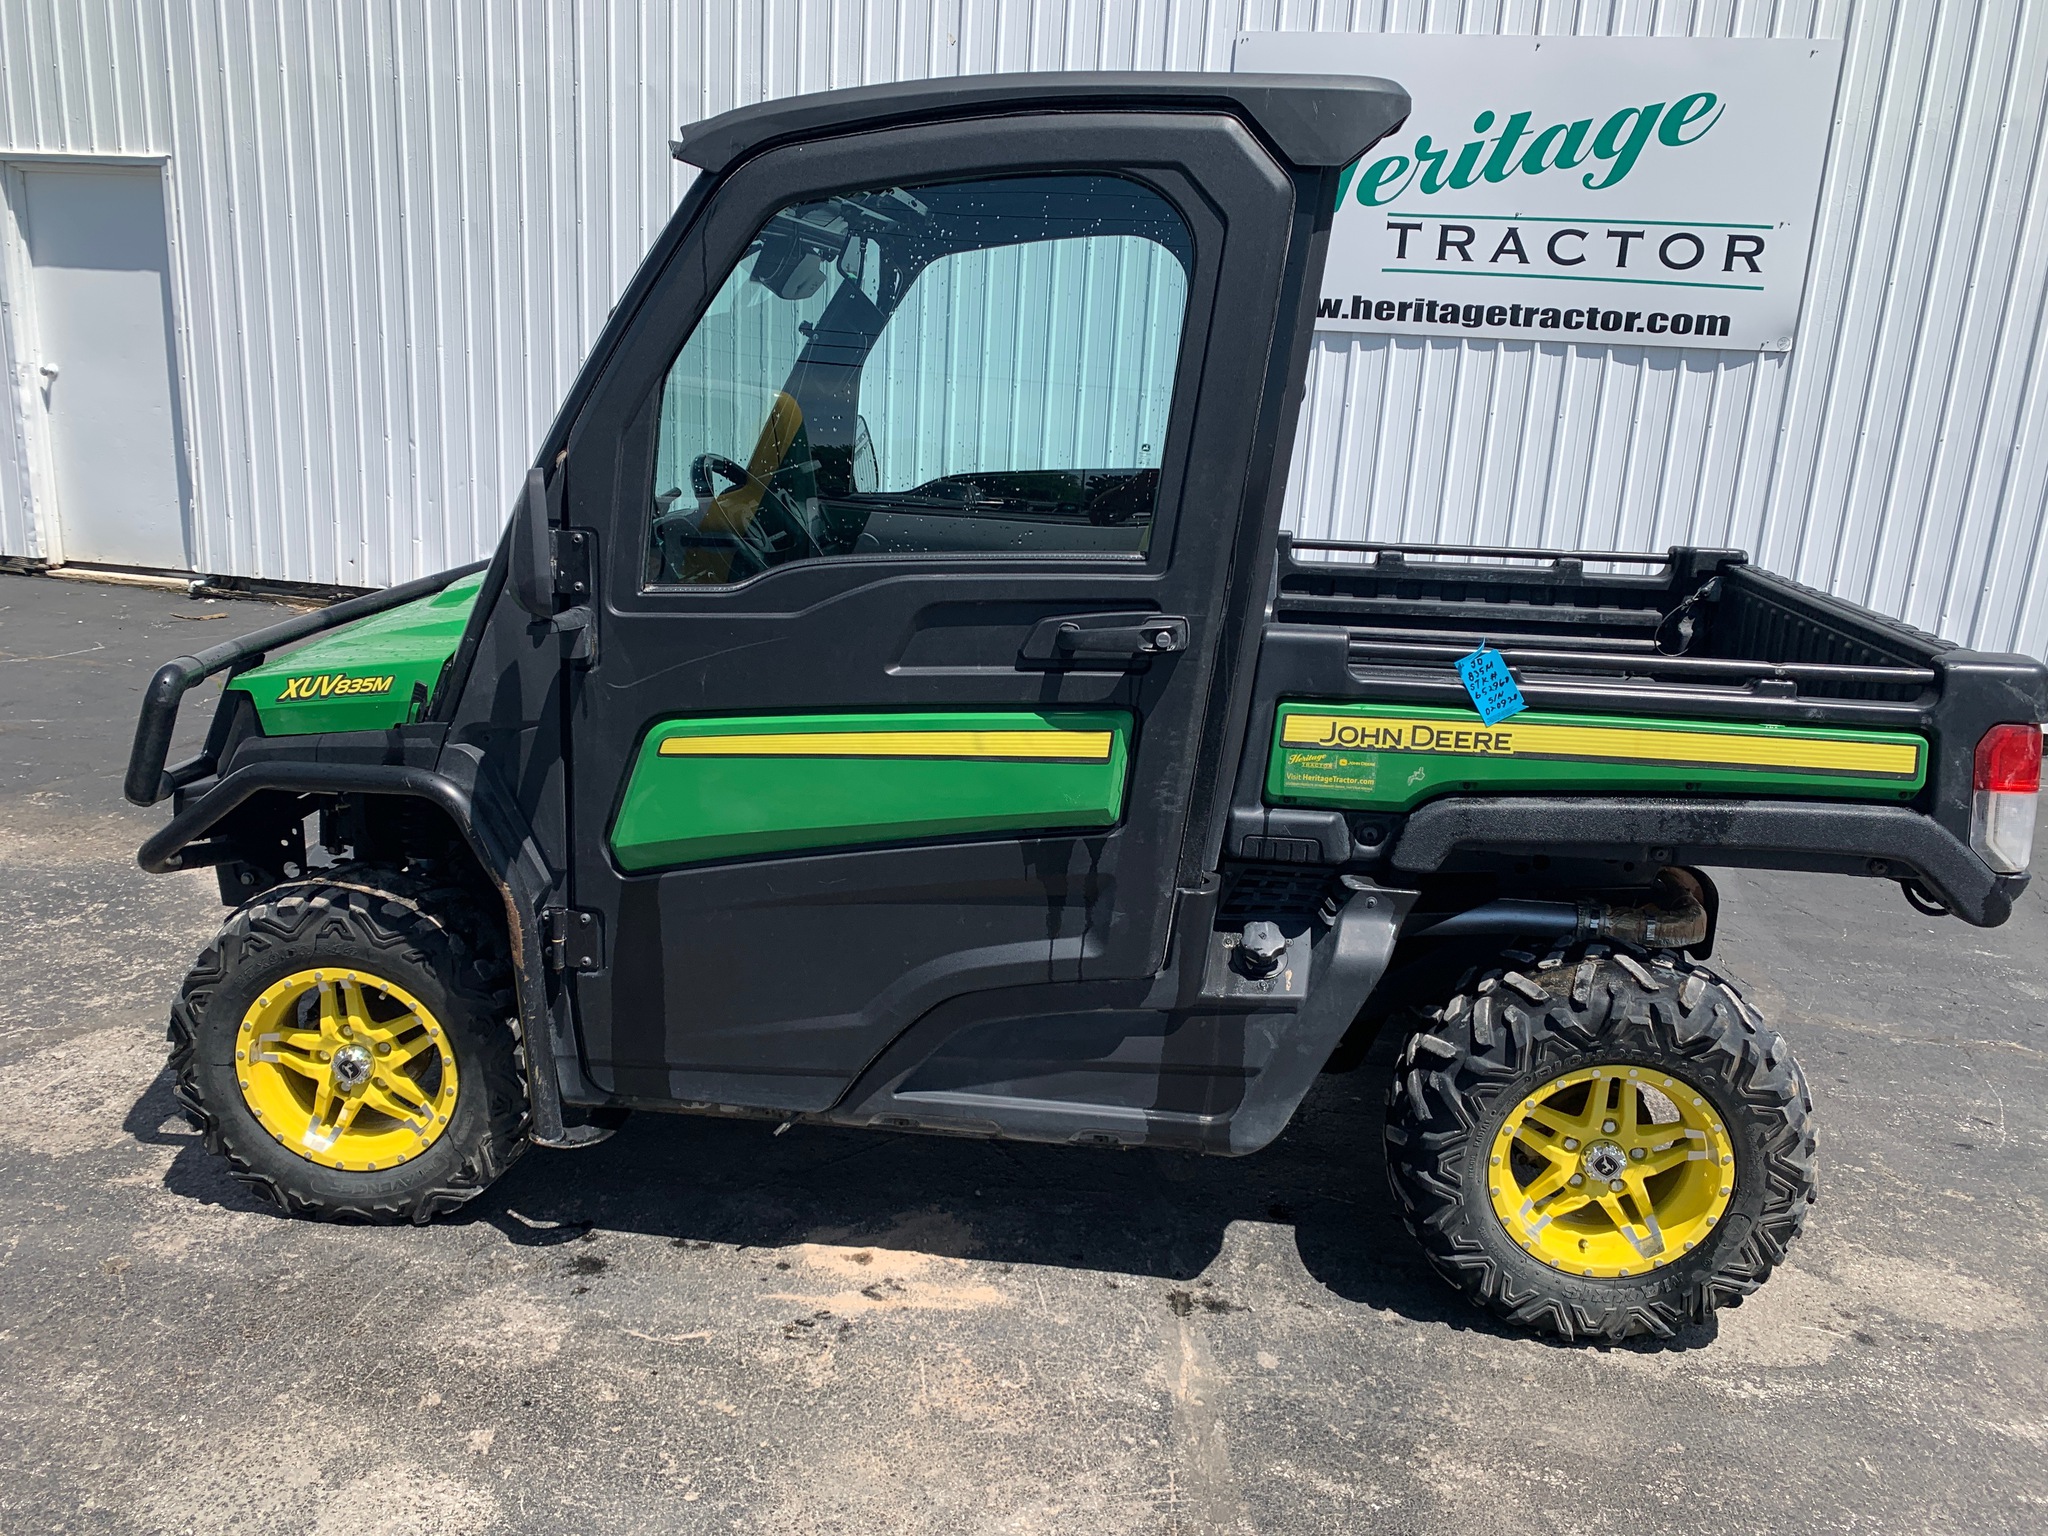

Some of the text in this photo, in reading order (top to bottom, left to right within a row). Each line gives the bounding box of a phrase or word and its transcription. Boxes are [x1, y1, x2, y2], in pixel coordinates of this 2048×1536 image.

[1386, 220, 1765, 274] TRACTOR
[1468, 661, 1493, 681] 835M
[276, 673, 395, 701] XUV835M
[1319, 721, 1513, 751] JOHN DEERE
[1288, 753, 1327, 764] Heritage
[1286, 772, 1375, 785] Visit HeritageTractor.com
